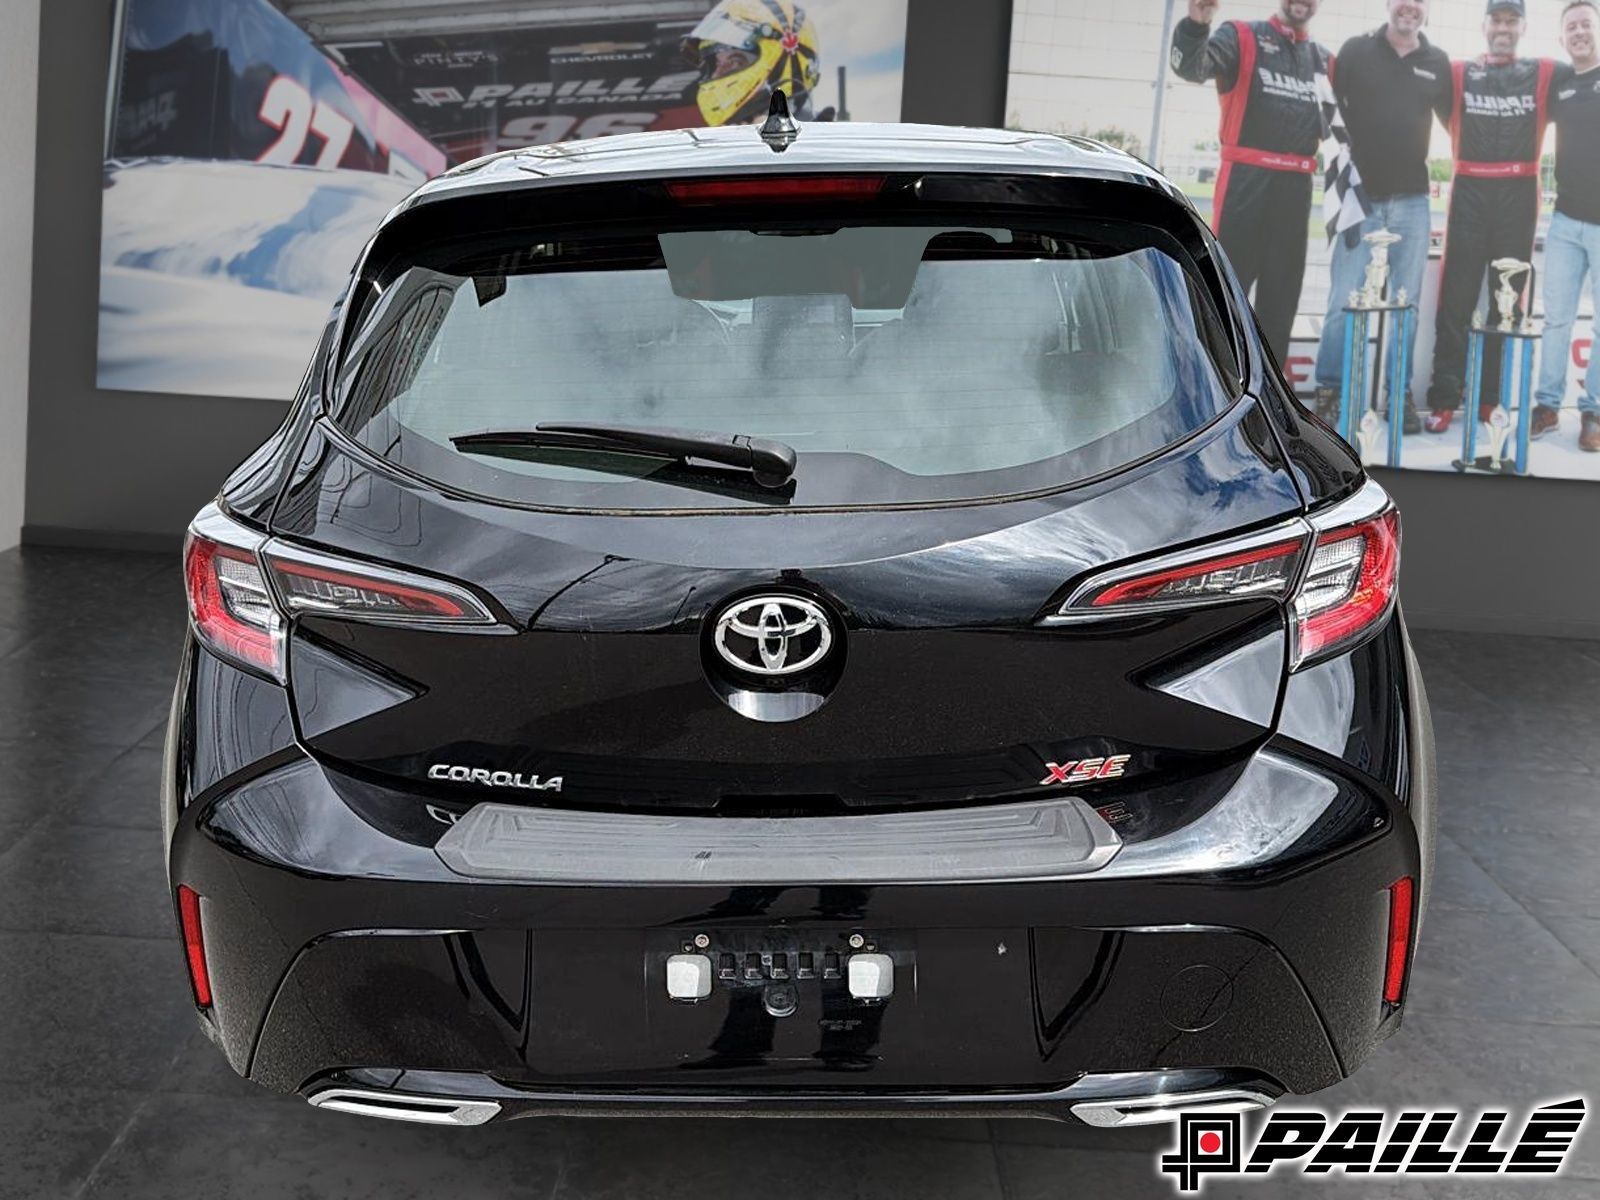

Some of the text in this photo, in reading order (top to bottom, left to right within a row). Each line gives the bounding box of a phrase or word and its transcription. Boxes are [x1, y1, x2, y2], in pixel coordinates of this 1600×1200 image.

[550, 53, 655, 64] CHEVROLET
[556, 92, 682, 105] CANADA
[427, 764, 563, 792] COROLLA
[1039, 754, 1131, 785] XSE
